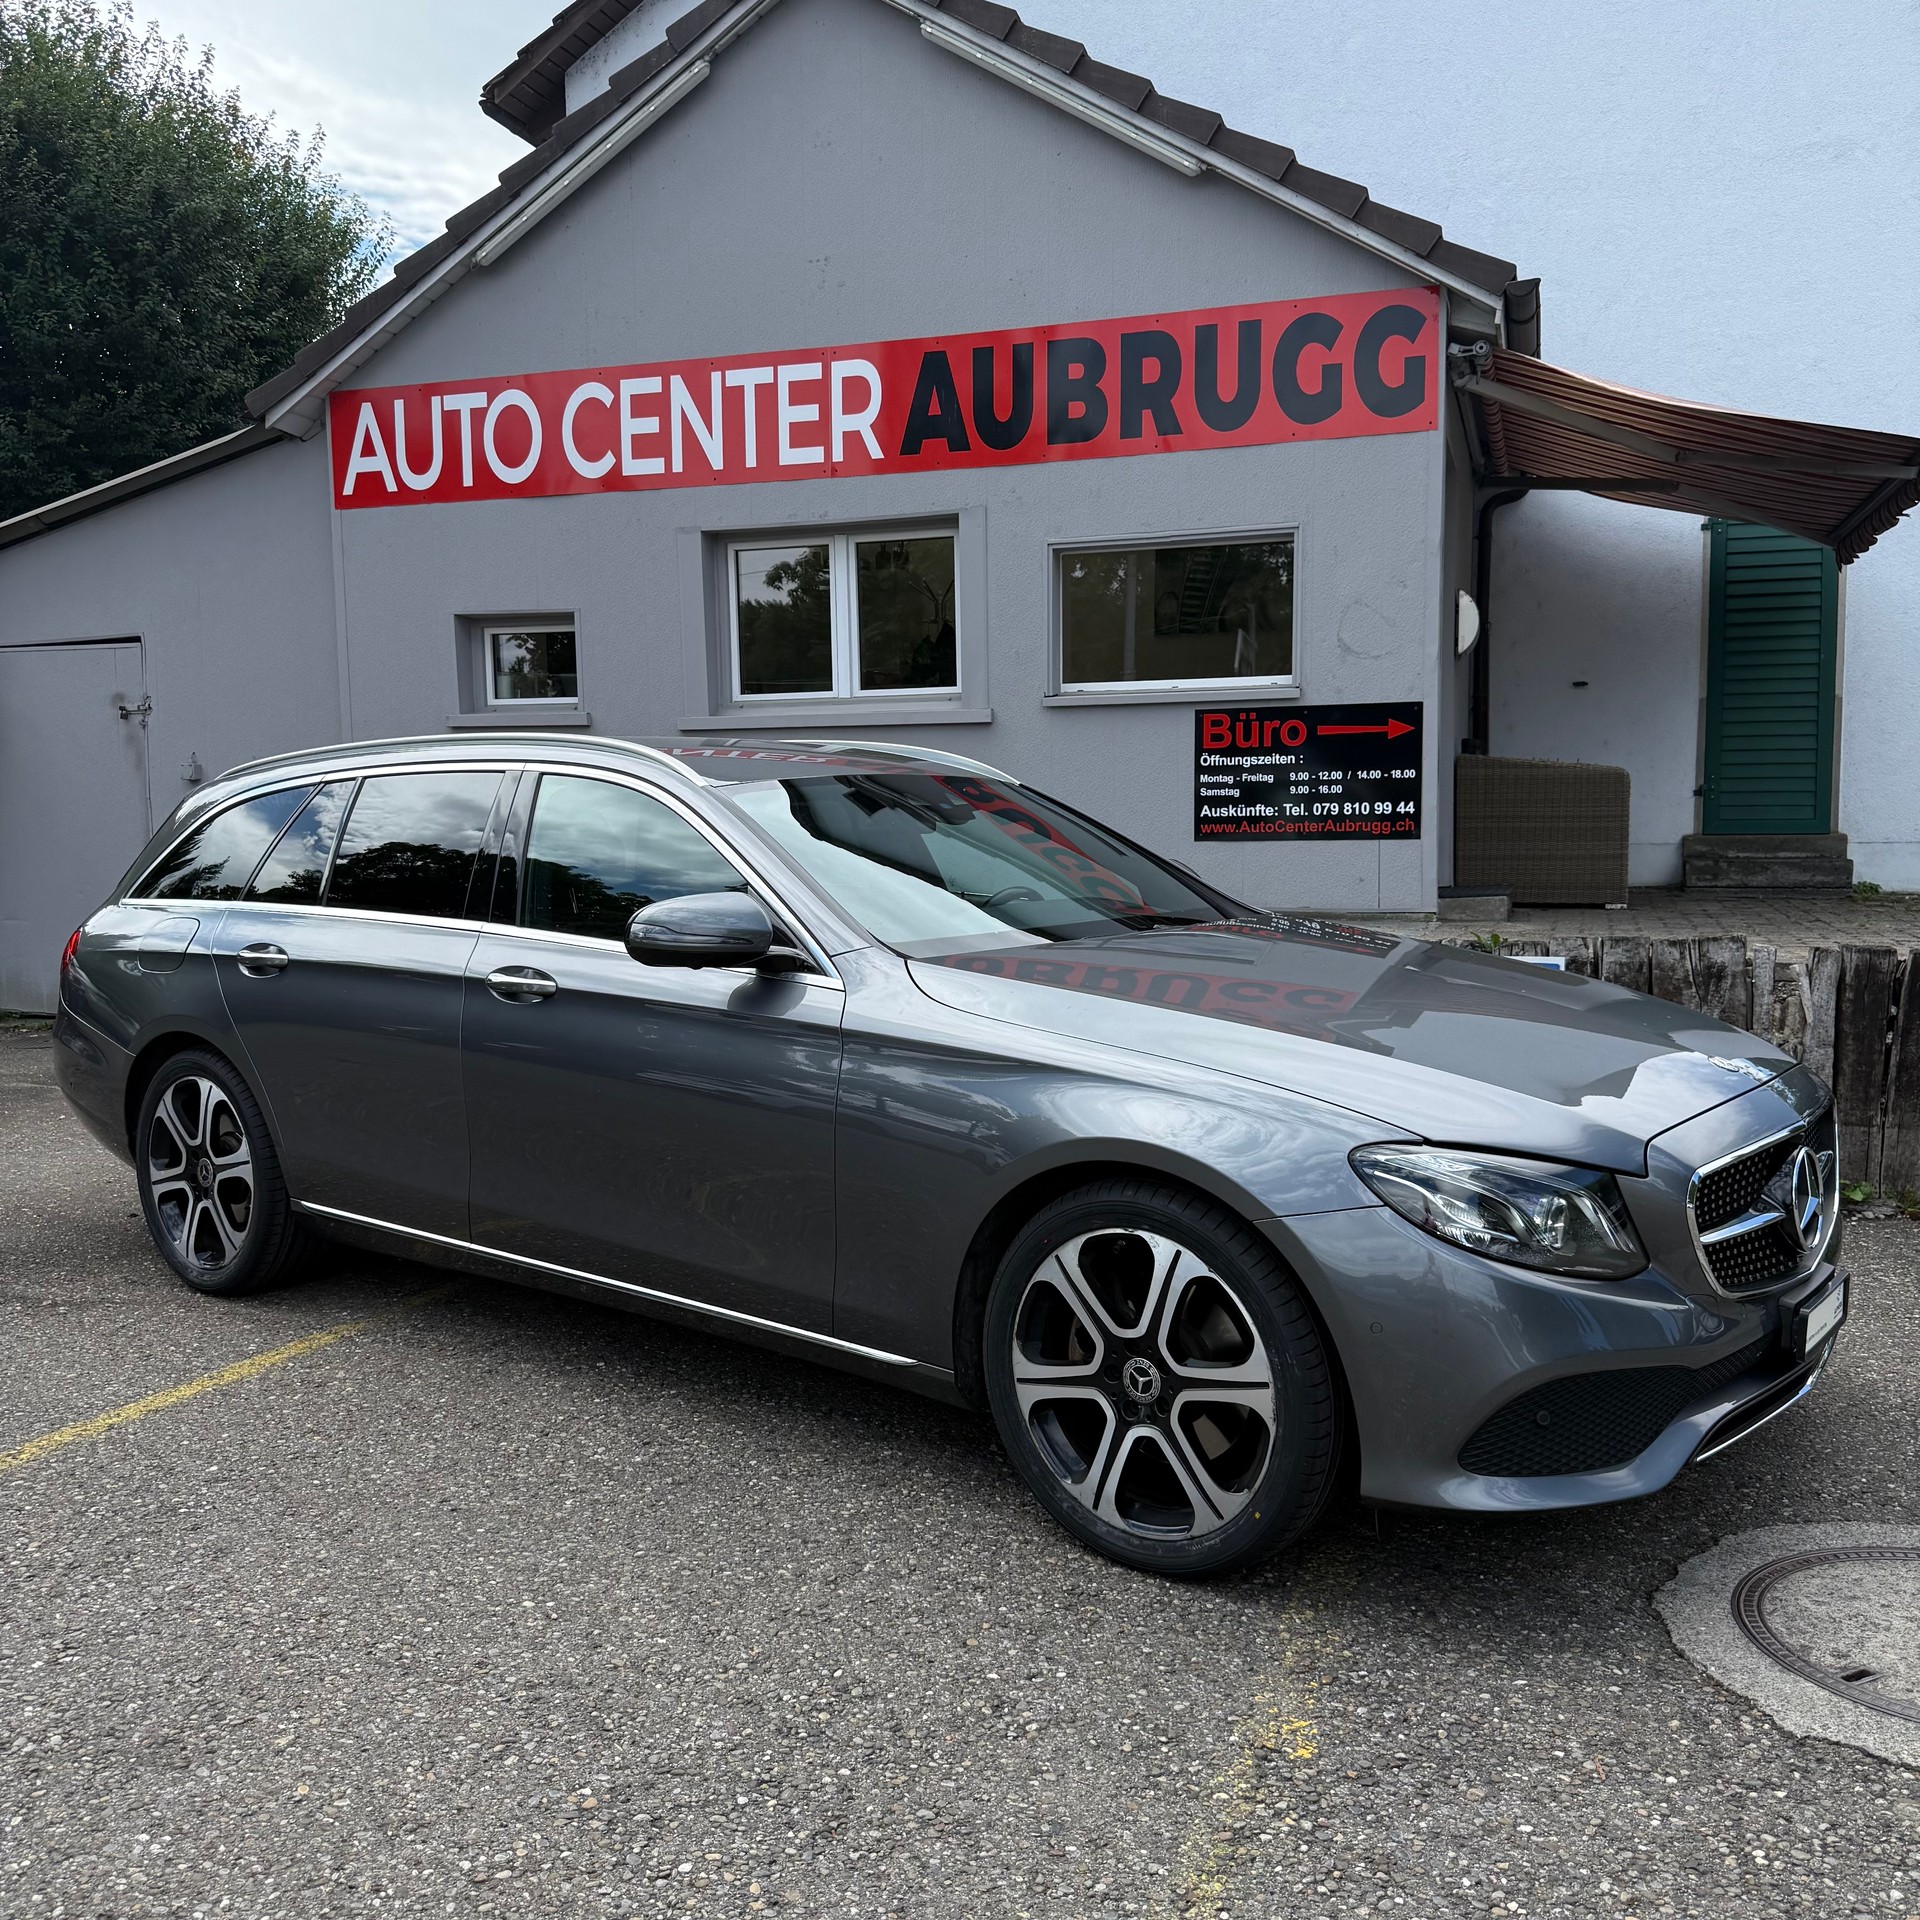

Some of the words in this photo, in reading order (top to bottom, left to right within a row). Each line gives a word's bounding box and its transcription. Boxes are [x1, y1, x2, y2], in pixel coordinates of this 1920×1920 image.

[342, 389, 542, 495] AUTO
[562, 359, 885, 479] CENTER
[900, 304, 1428, 456] AUBRUGG
[1203, 712, 1307, 749] Büro
[1200, 753, 1295, 768] Öffnungszeiten
[1200, 774, 1234, 784] Montag
[1242, 773, 1274, 784] Freitag
[1289, 772, 1309, 781] 9.00
[1318, 771, 1343, 780] 12.00
[1357, 770, 1381, 779] 14.00
[1391, 769, 1416, 779] 18.00
[1200, 787, 1240, 798] Samstag
[1289, 785, 1309, 794] 9.00
[1318, 785, 1343, 794] 16.00
[1200, 804, 1279, 817] Auskünfte:
[1283, 803, 1308, 816] Tel.
[1313, 802, 1339, 816] 079
[1343, 802, 1370, 815] 810
[1374, 801, 1393, 815] 99
[1396, 801, 1416, 814] 44
[1200, 818, 1415, 834] www.AutoCenterAubrugg.ch
